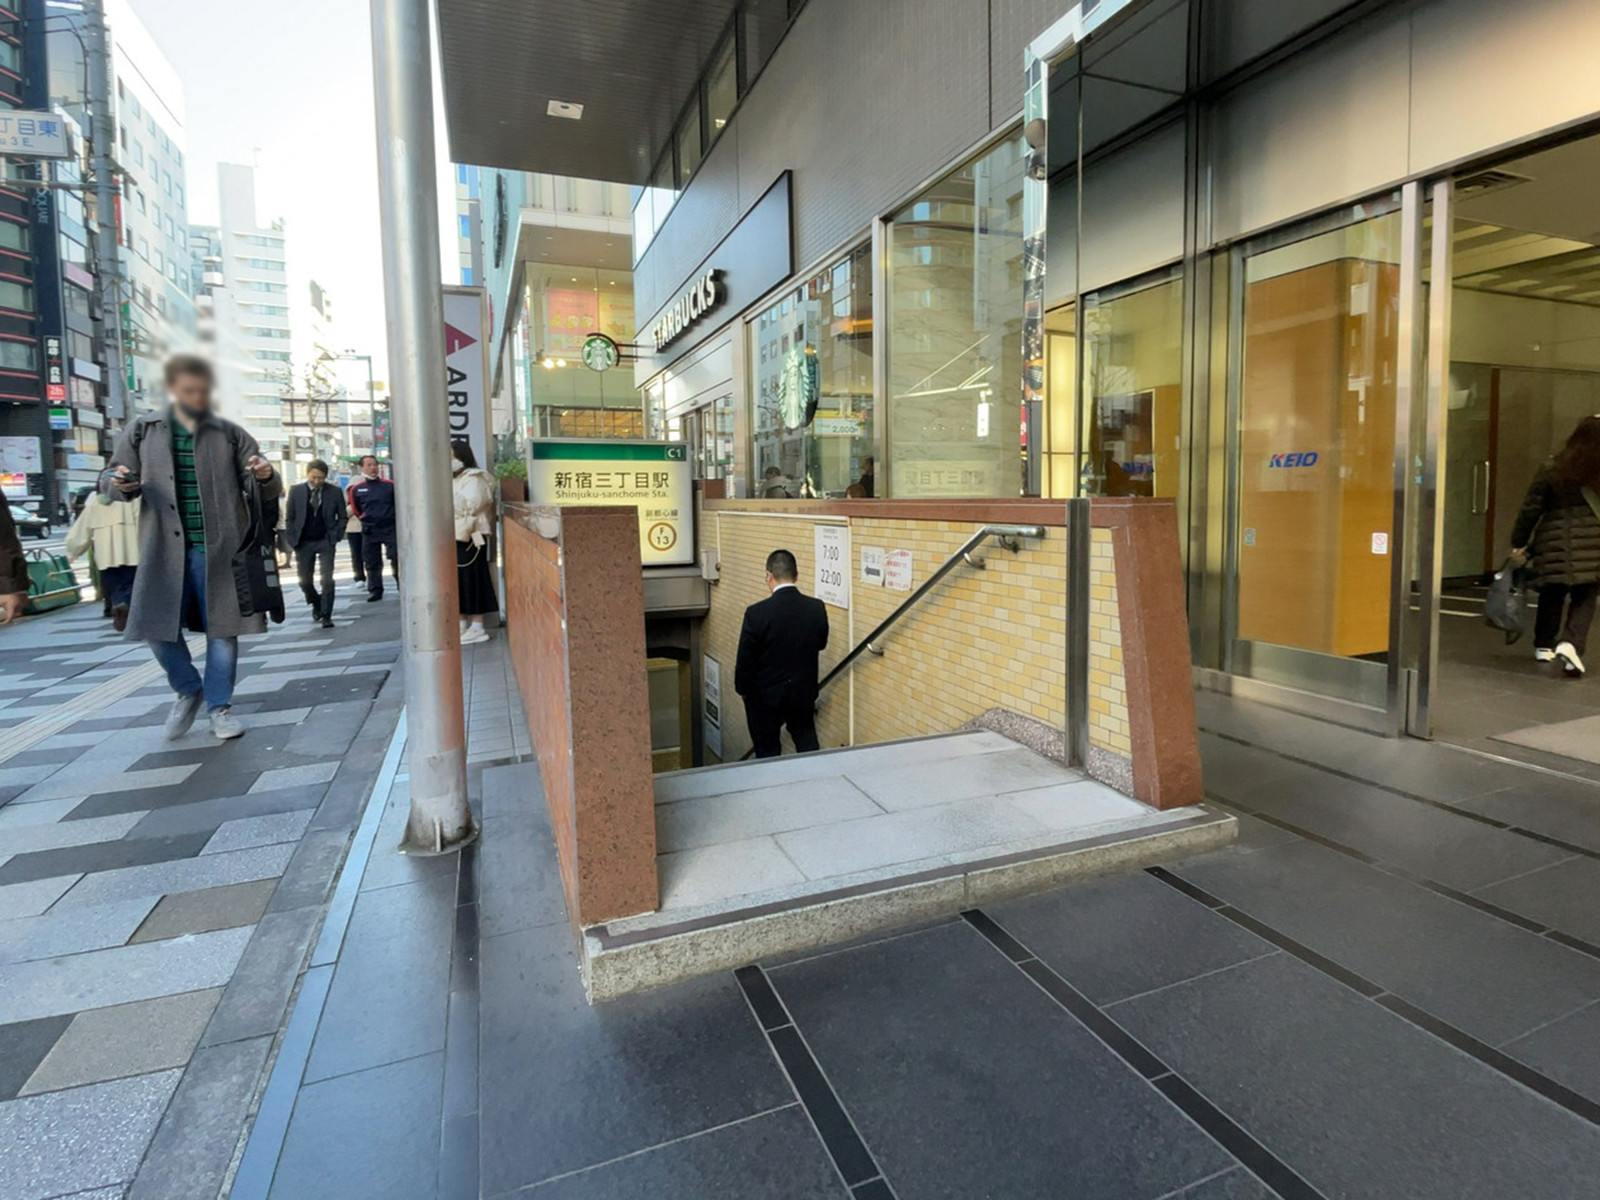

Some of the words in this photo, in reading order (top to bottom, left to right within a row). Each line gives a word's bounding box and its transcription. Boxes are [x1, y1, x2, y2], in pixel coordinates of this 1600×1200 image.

[652, 268, 720, 353] STARBUCKS
[667, 448, 682, 458] C1
[1269, 452, 1318, 468] KEIO
[555, 472, 669, 489] 新宿三丁目駅
[555, 490, 649, 500] Shinjuku-sanchome
[652, 489, 669, 498] Sta.
[659, 527, 664, 535] F
[656, 536, 669, 545] 13
[822, 544, 840, 561] 7:00
[820, 568, 842, 587] 22:00
